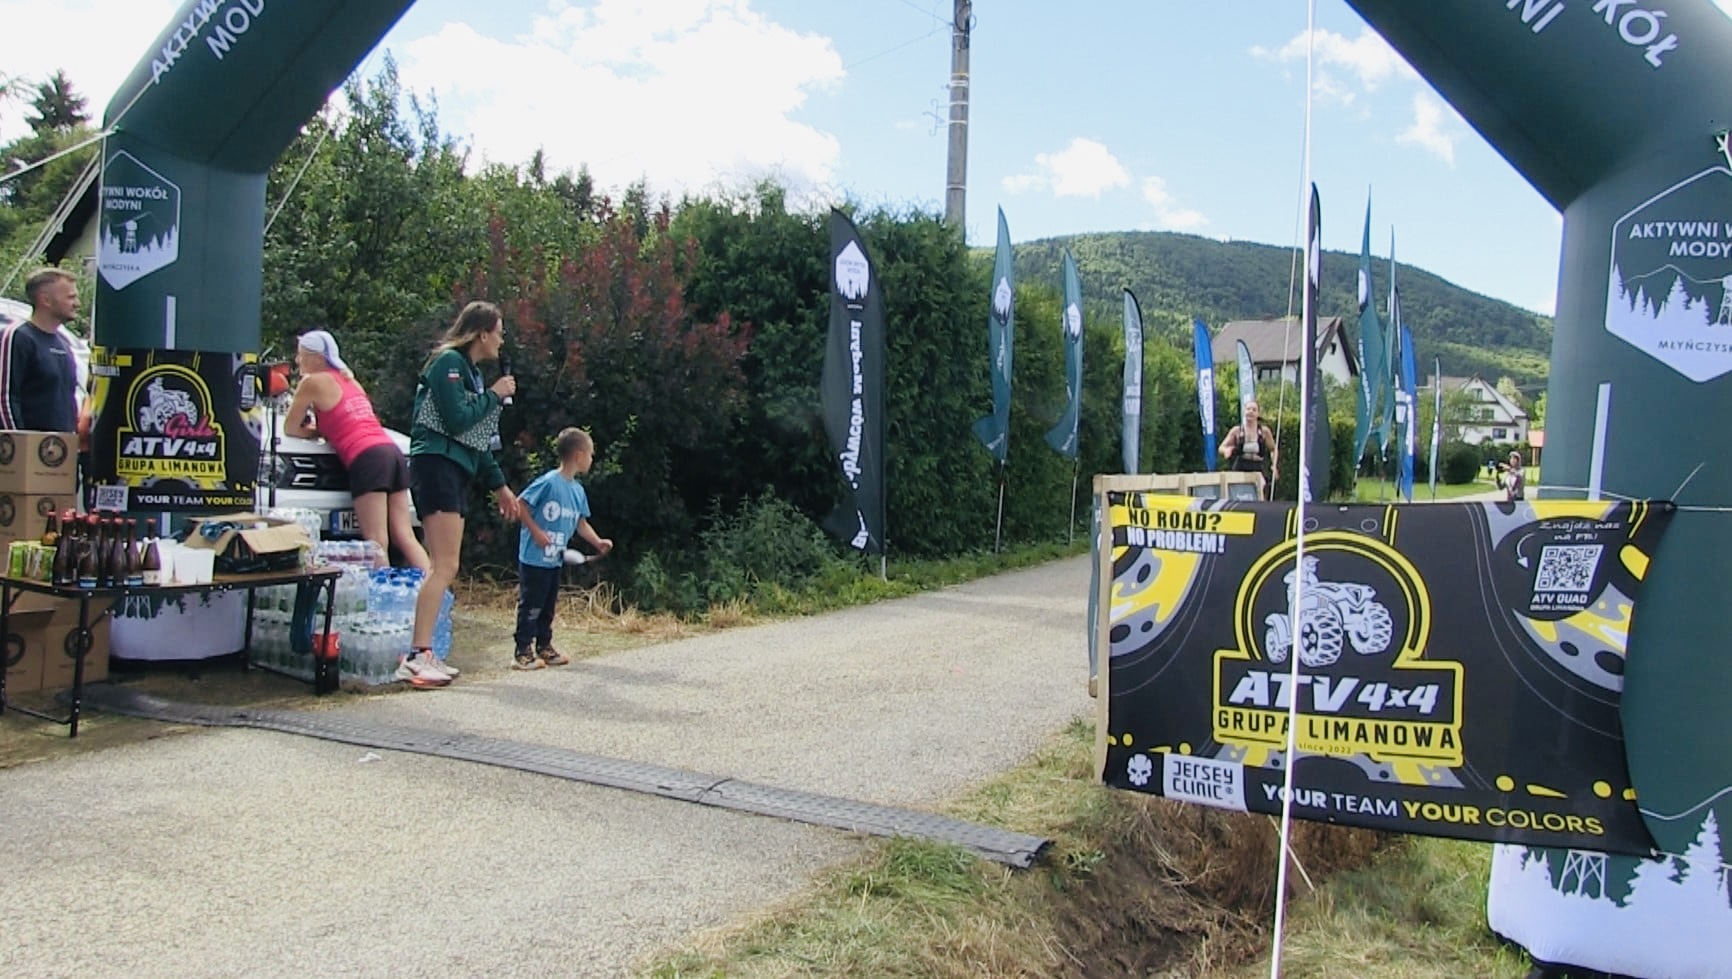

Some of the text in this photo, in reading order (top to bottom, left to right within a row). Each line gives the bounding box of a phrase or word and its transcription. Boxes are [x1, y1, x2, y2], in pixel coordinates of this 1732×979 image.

[206, 0, 265, 60] MOD
[1592, 0, 1678, 68] KÓŁ
[125, 186, 168, 200] WOKÓŁ
[1629, 221, 1718, 239] AKTYWNI
[1669, 241, 1732, 258] MODY
[1658, 338, 1732, 353] MŁYŃCZYS
[123, 436, 217, 457] ATV 4x4
[118, 459, 224, 474] GRUPA LIMANOWA
[137, 494, 170, 505] YOUR
[171, 495, 204, 506] TEAM
[205, 496, 233, 506] YOUR
[1130, 509, 1222, 531] NO ROAD?
[1127, 526, 1226, 554] NO PROBLEM!
[1531, 593, 1588, 605] ATV QUAD
[1228, 670, 1440, 714] ATV 4x4
[1218, 710, 1456, 750] GRUPA LIMANOWA
[1299, 743, 1352, 754] since 2022
[1173, 761, 1234, 785] JERSEY
[1262, 783, 1606, 836] YOUR TEAM YOUR COLORS
